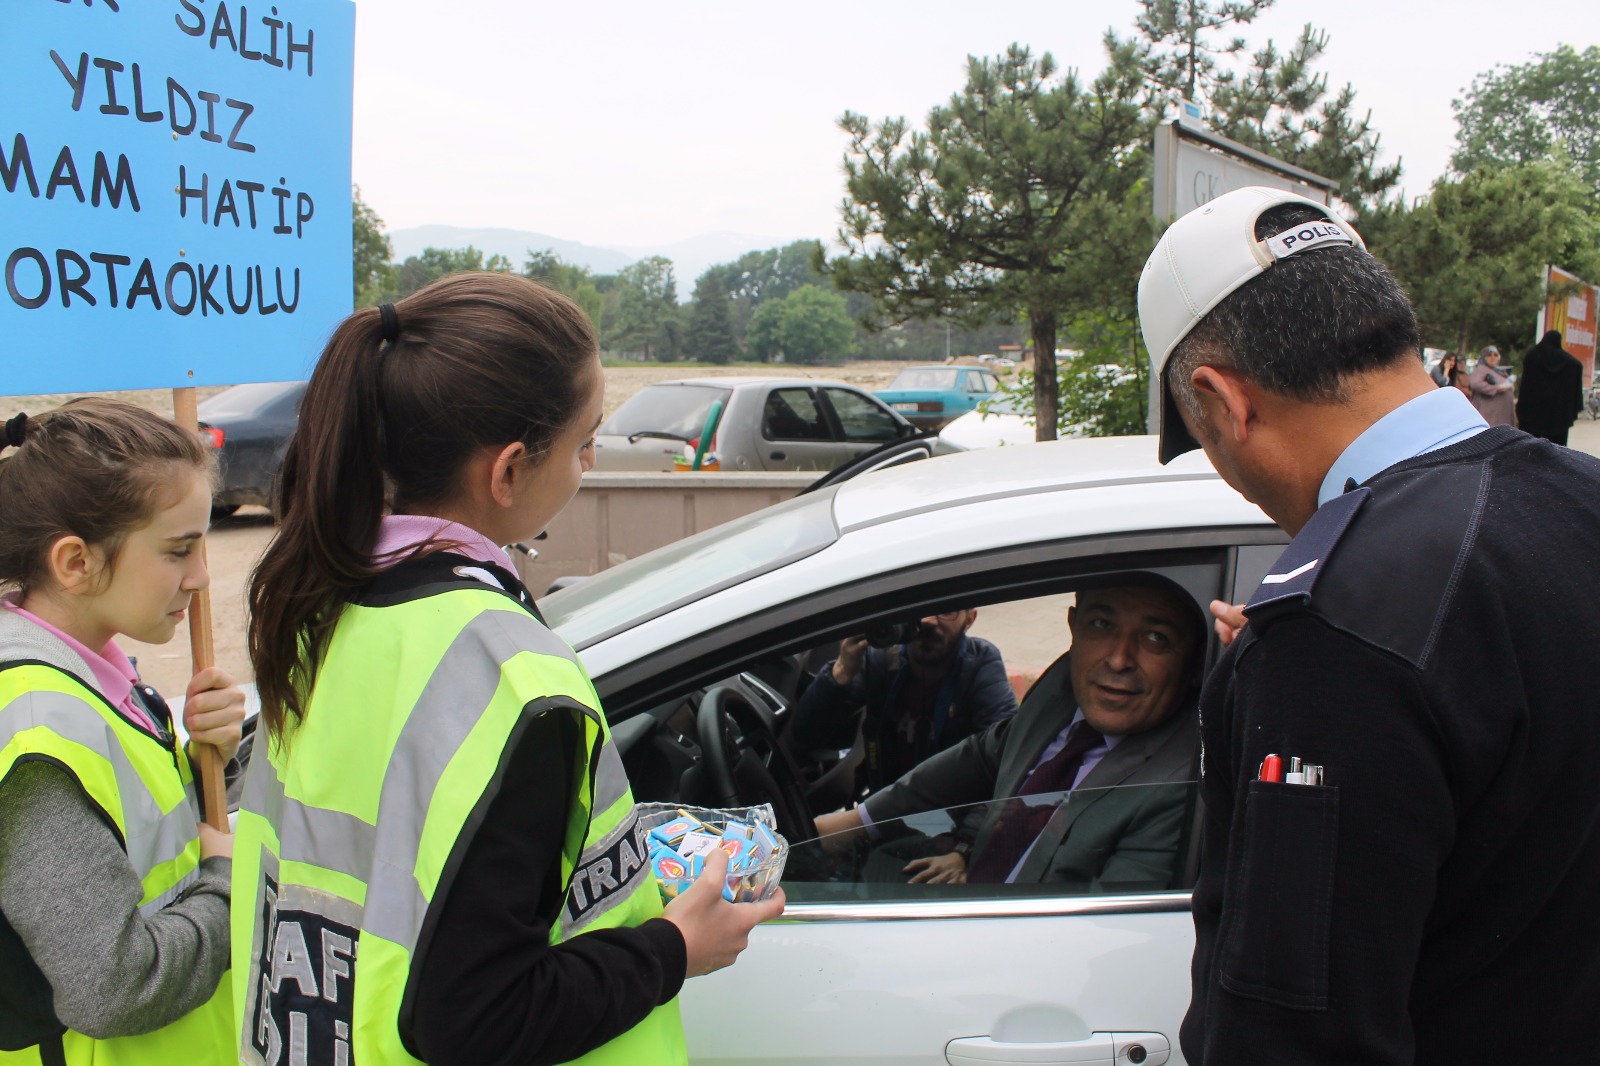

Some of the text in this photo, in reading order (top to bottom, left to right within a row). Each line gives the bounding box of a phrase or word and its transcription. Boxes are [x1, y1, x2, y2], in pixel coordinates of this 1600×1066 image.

[175, 0, 314, 77] SALİH
[50, 49, 256, 153] YILDIZ
[179, 164, 315, 239] HATİP
[1281, 224, 1341, 249] POLİS
[4, 246, 300, 317] ORTAOKULU
